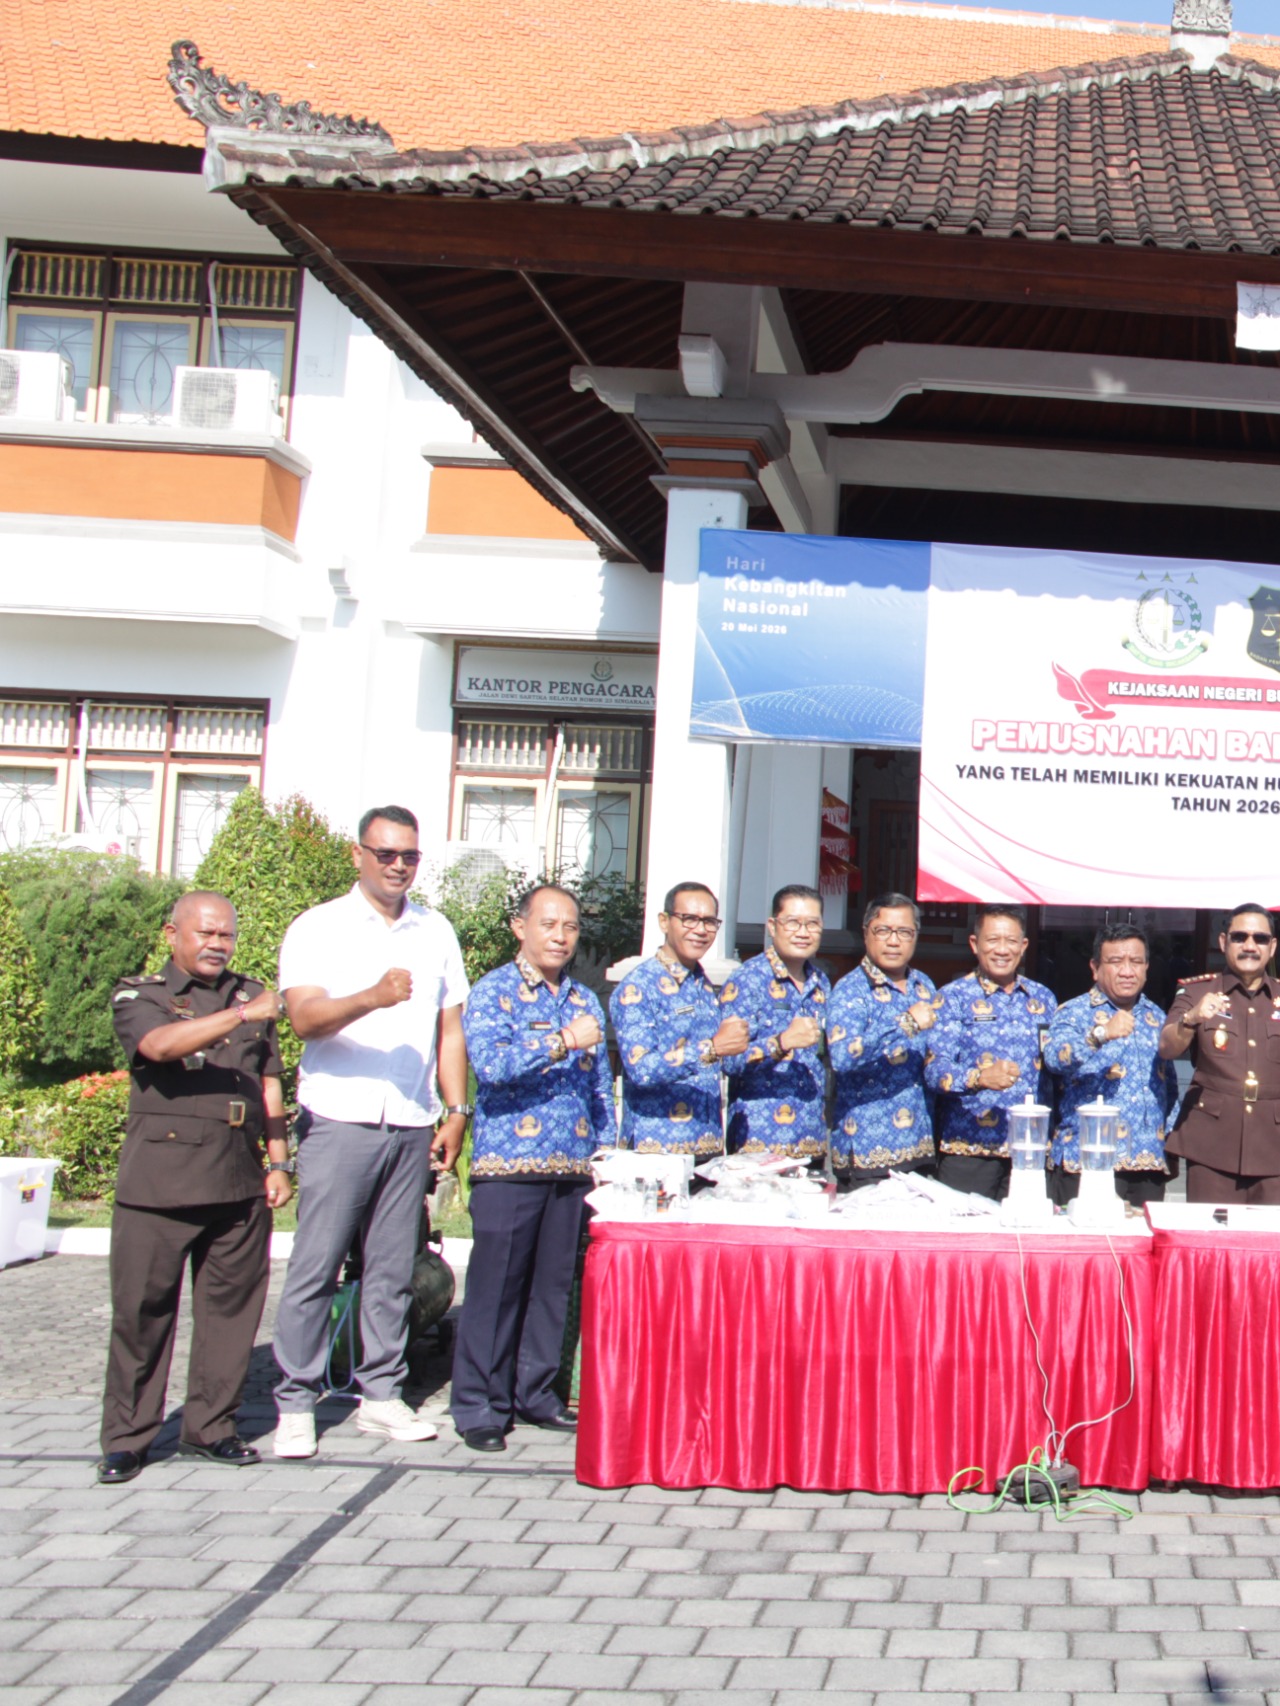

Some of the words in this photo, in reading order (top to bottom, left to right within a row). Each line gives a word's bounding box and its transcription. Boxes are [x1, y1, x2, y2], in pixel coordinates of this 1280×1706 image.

[726, 556, 766, 571] Hari
[724, 577, 847, 598] Kebangkitan
[723, 598, 808, 617] Nasional
[721, 622, 735, 632] 20
[738, 623, 758, 632] Mei
[761, 625, 787, 634] 2026
[467, 677, 542, 693] KANTOR
[548, 681, 656, 698] PENGACARA
[1108, 681, 1200, 700] KEJAKSAAN
[1203, 686, 1262, 702] NEGERI
[971, 719, 1218, 760] PEMUSNAHAN
[956, 764, 1005, 780] YANG
[1011, 766, 1067, 782] TELAH
[1073, 769, 1159, 786] MEMILIKI
[1165, 772, 1258, 790] KEKUATAN
[1172, 796, 1231, 812] TAHUN
[1236, 799, 1280, 814] 2026
